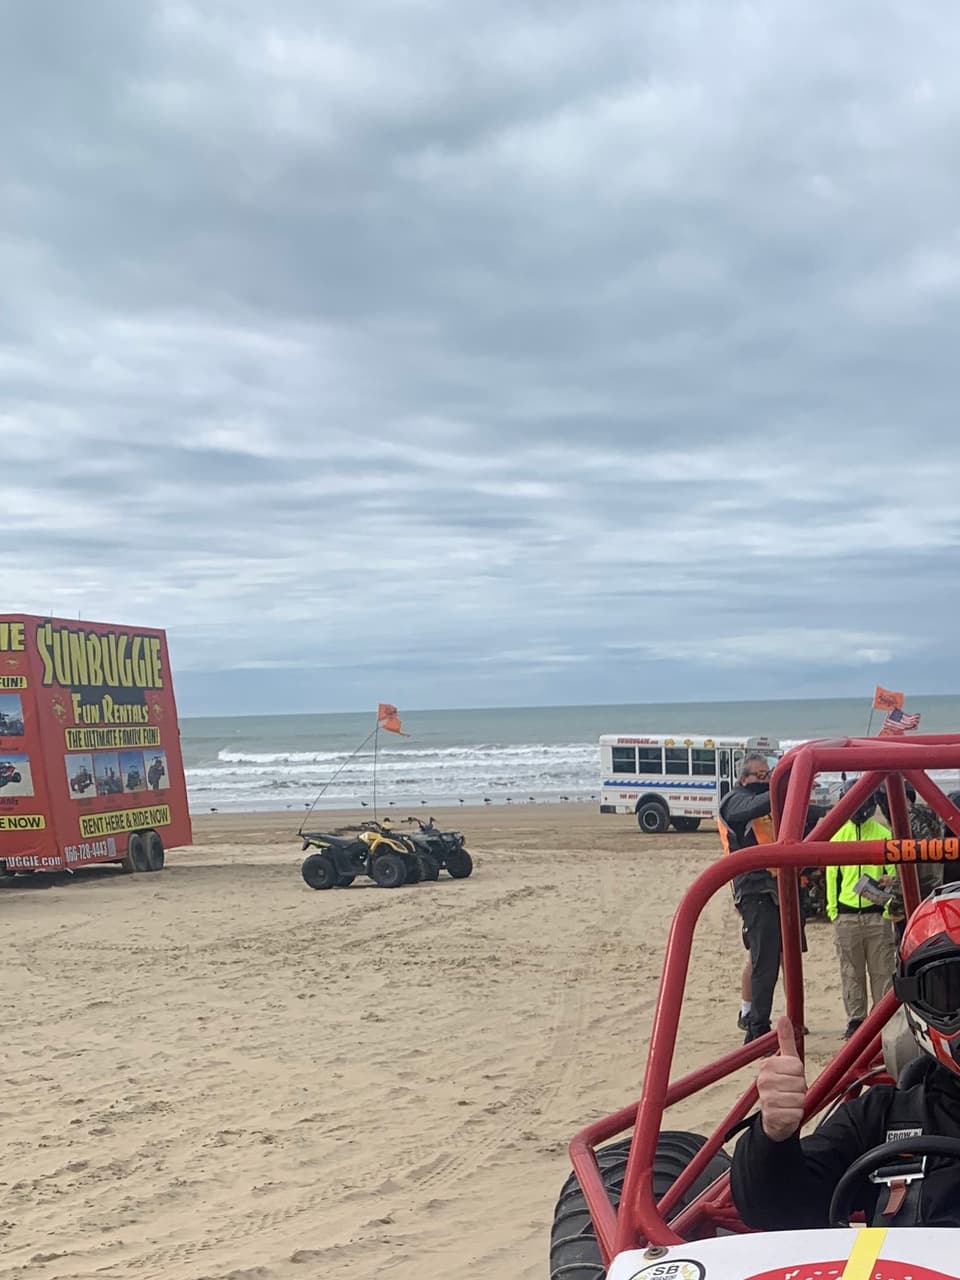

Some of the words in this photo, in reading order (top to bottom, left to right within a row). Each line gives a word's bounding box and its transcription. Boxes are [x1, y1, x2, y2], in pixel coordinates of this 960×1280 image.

[37, 623, 163, 688] SUNBUGGIE
[8, 817, 41, 828] NOW
[82, 817, 104, 835] RENT
[104, 814, 125, 832] HERE
[126, 812, 133, 828] &
[133, 810, 150, 827] RIDE
[149, 807, 168, 825] NOW
[887, 837, 959, 861] SB109
[652, 1264, 680, 1276] SB
